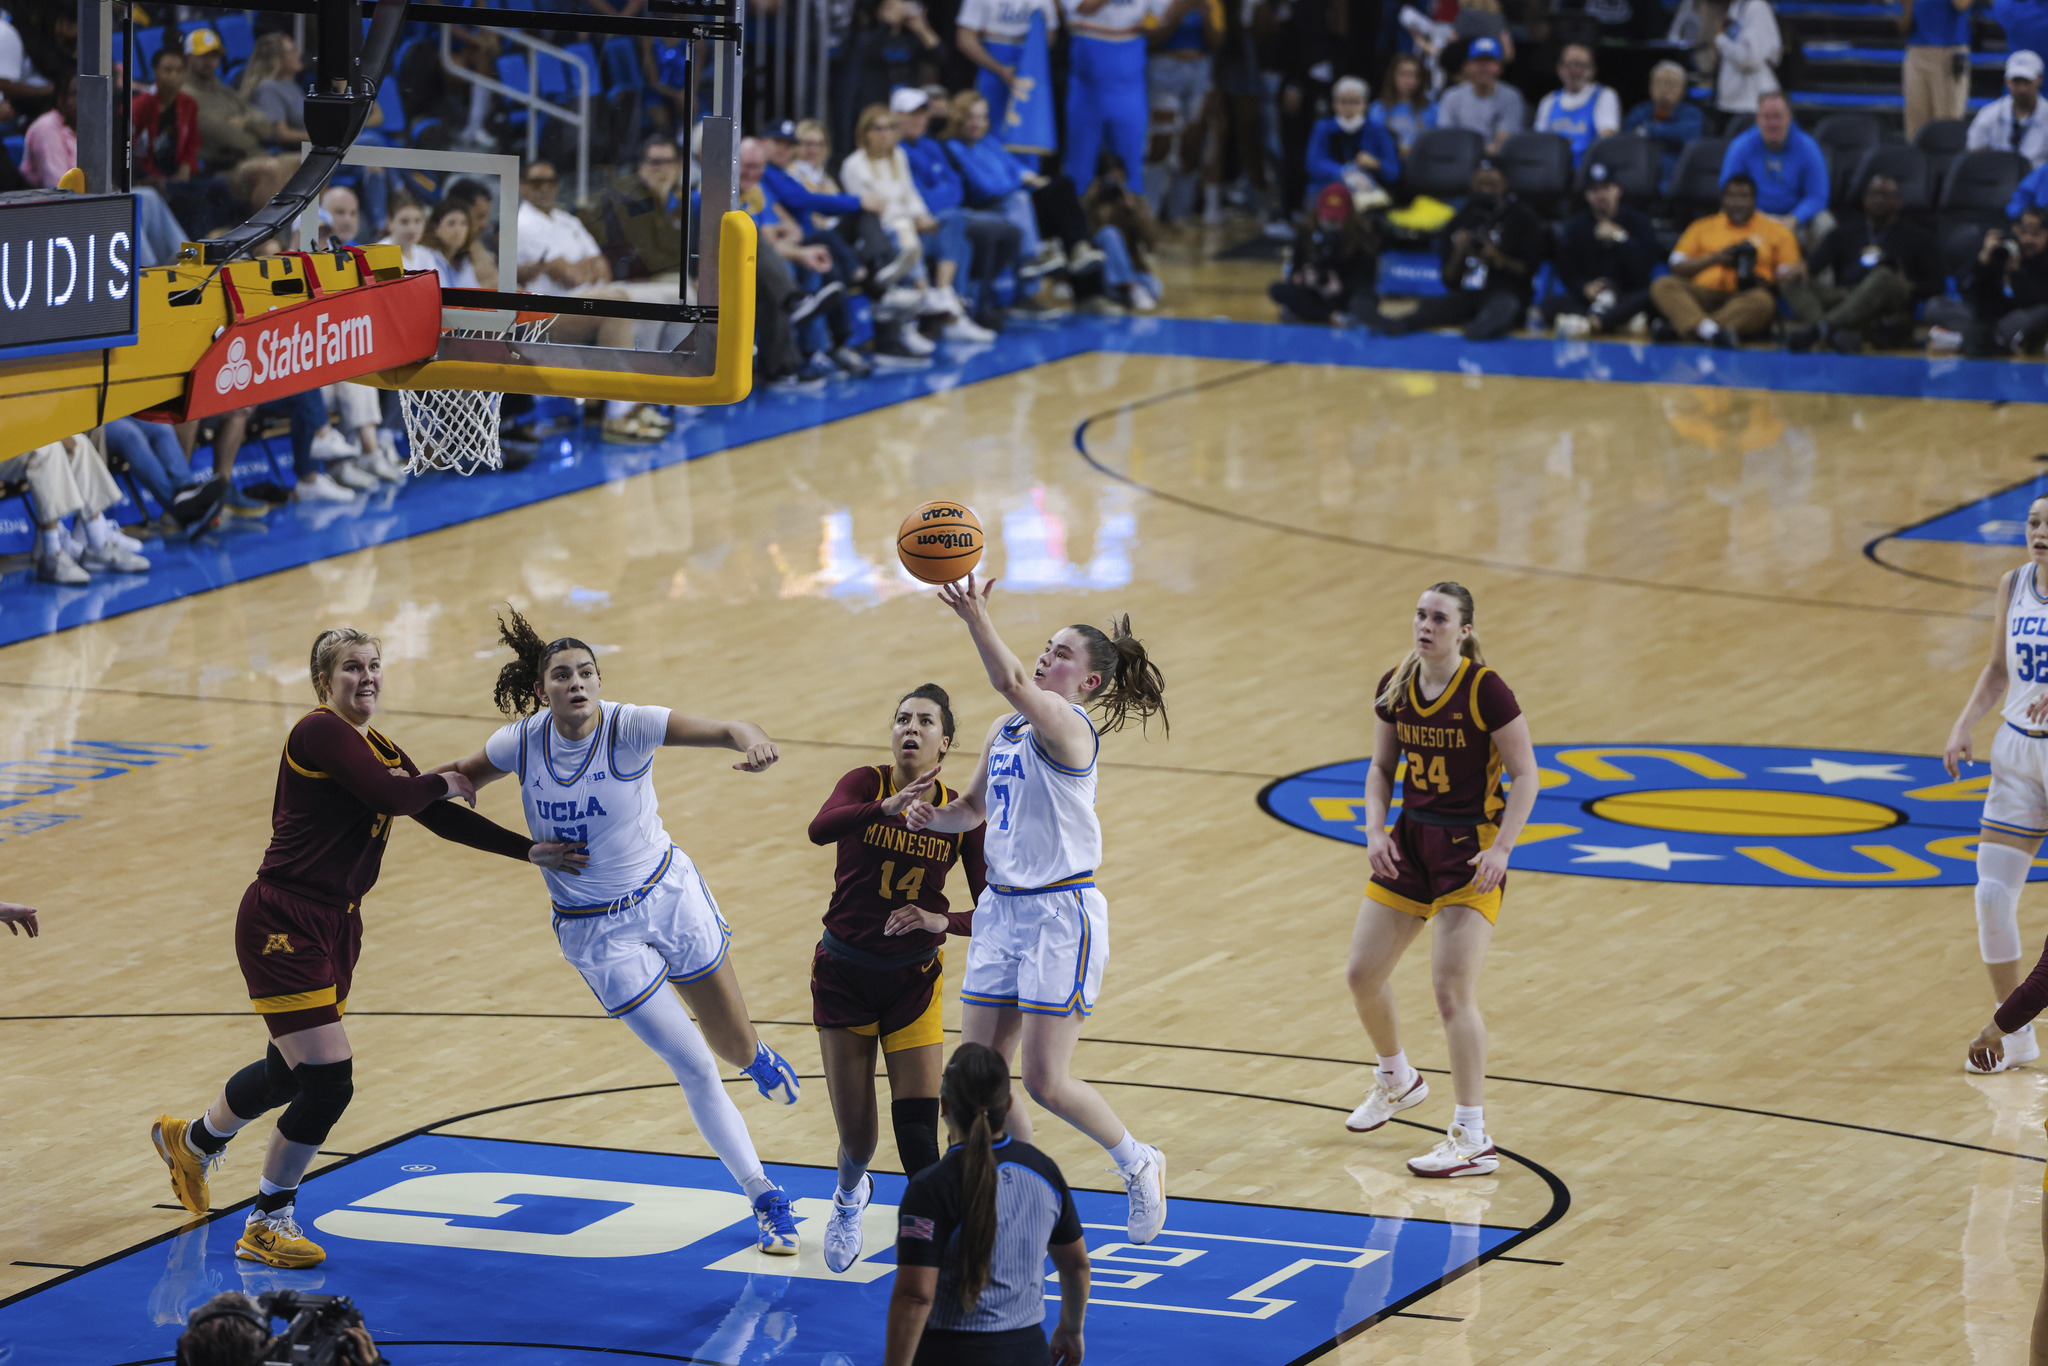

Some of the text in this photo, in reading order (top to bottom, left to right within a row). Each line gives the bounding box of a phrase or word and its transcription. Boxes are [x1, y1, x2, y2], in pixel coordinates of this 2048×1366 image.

[921, 508, 963, 521] NCAA
[917, 532, 974, 549] Wilson
[2016, 642, 2048, 684] 32
[1407, 752, 1451, 793] 24
[536, 796, 607, 822] UCLA
[993, 784, 1010, 830] 7
[863, 823, 951, 863] MINNESOTA
[878, 860, 926, 900] 14
[262, 933, 295, 955] M
